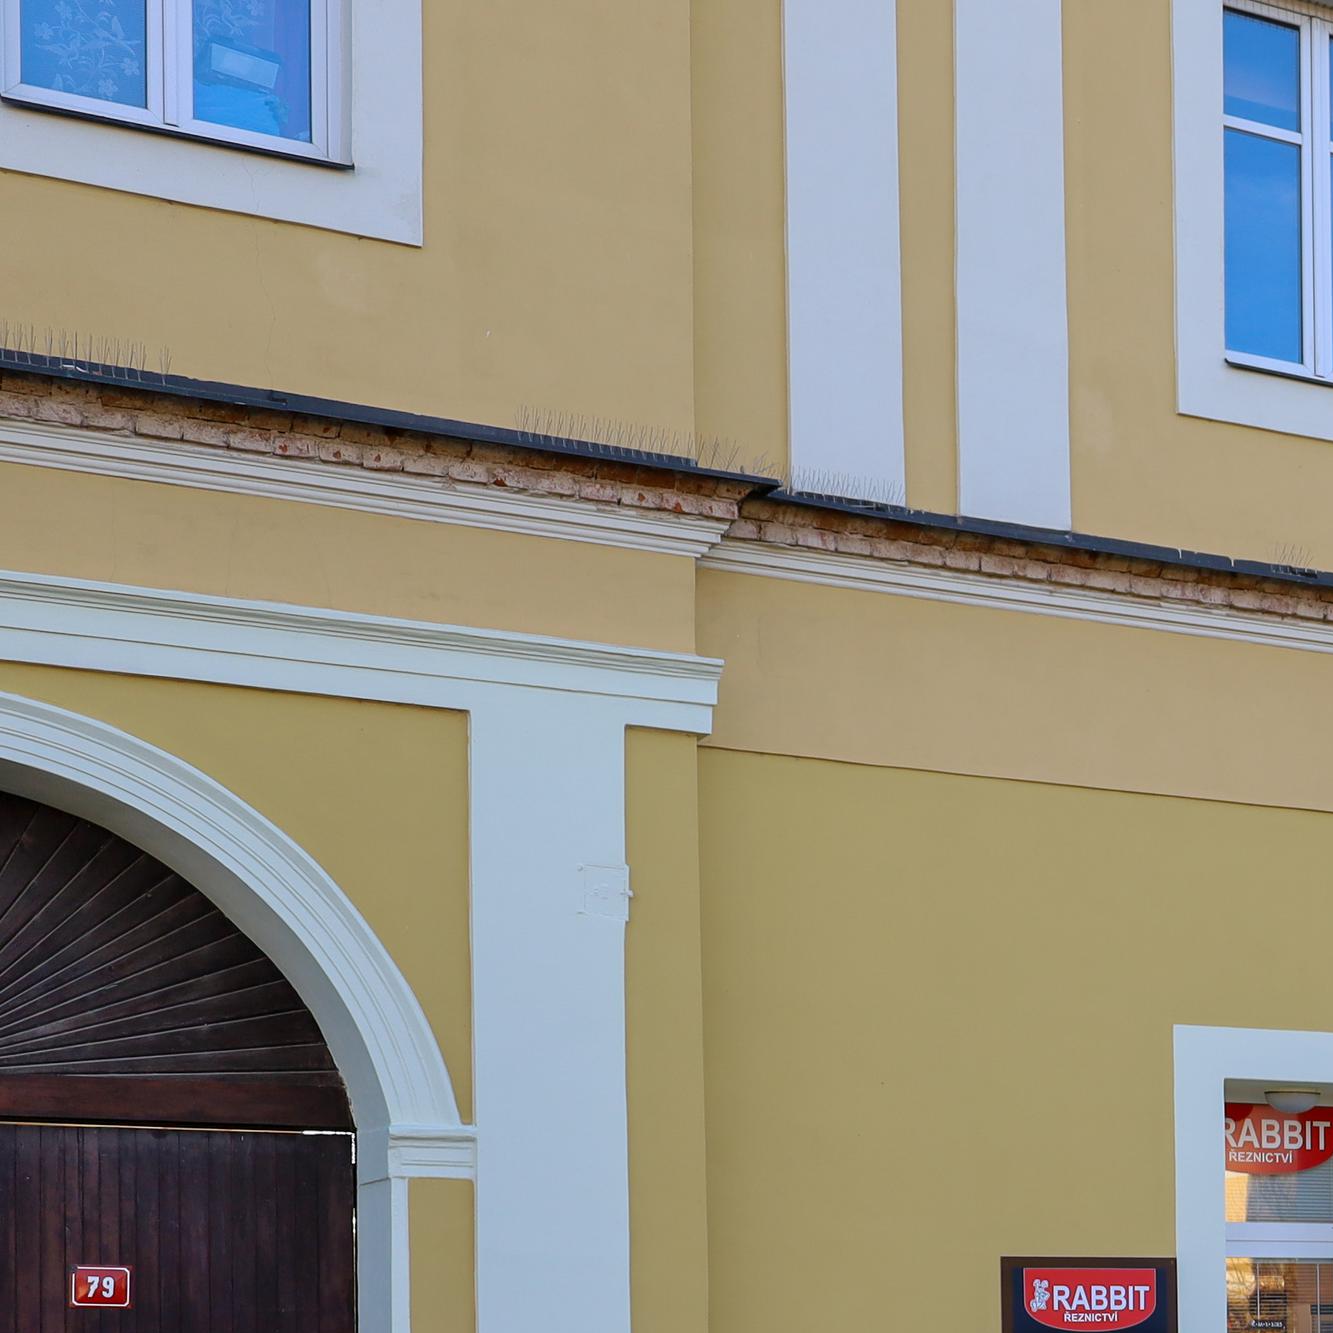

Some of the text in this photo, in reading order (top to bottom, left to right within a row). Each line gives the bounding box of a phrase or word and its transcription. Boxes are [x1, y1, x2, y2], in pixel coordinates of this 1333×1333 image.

[1229, 1149, 1293, 1163] ŘEZNICTVÍ
[87, 1276, 115, 1298] 79
[1053, 1285, 1150, 1311] RABBIT
[1064, 1311, 1118, 1323] ŘEZNICTVÍ
